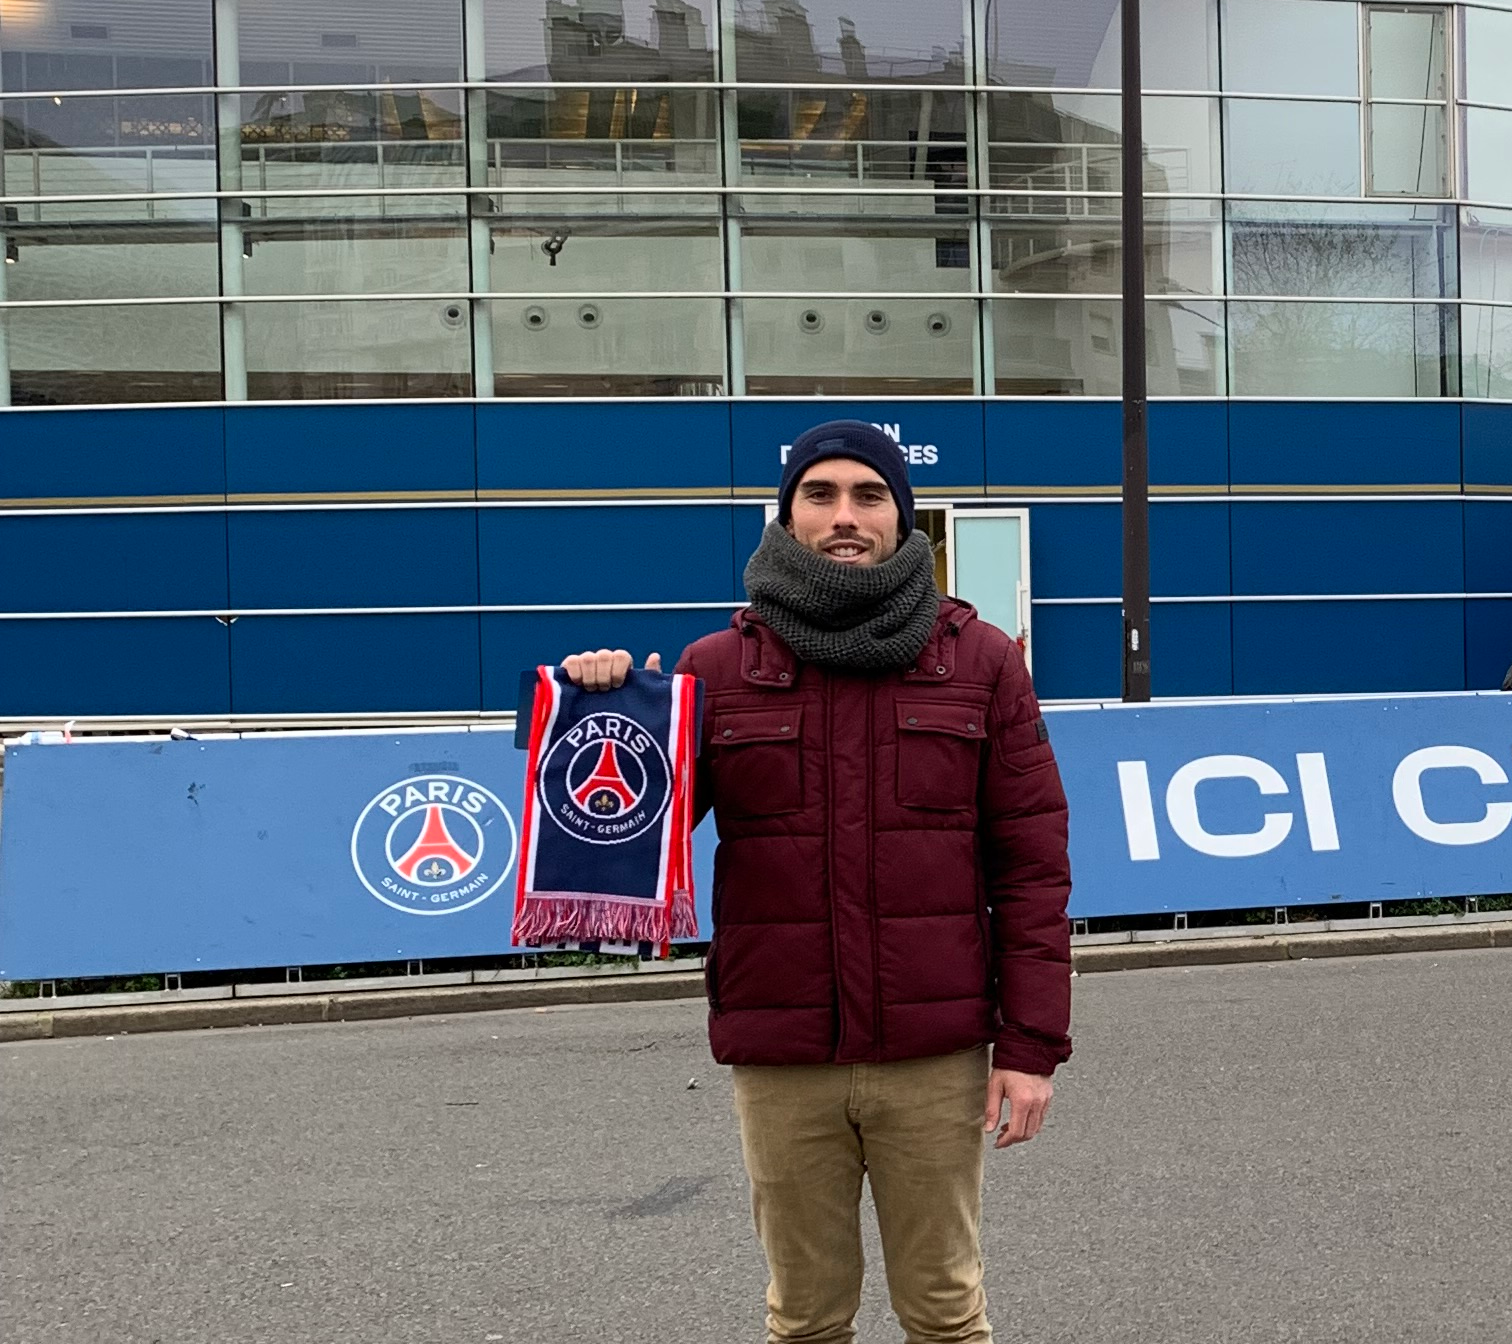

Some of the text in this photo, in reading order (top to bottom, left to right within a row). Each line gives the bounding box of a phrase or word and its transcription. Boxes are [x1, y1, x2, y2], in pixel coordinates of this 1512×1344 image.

[565, 718, 651, 754] PARIS
[379, 781, 487, 817] PARIS
[1117, 751, 1341, 861] ICI
